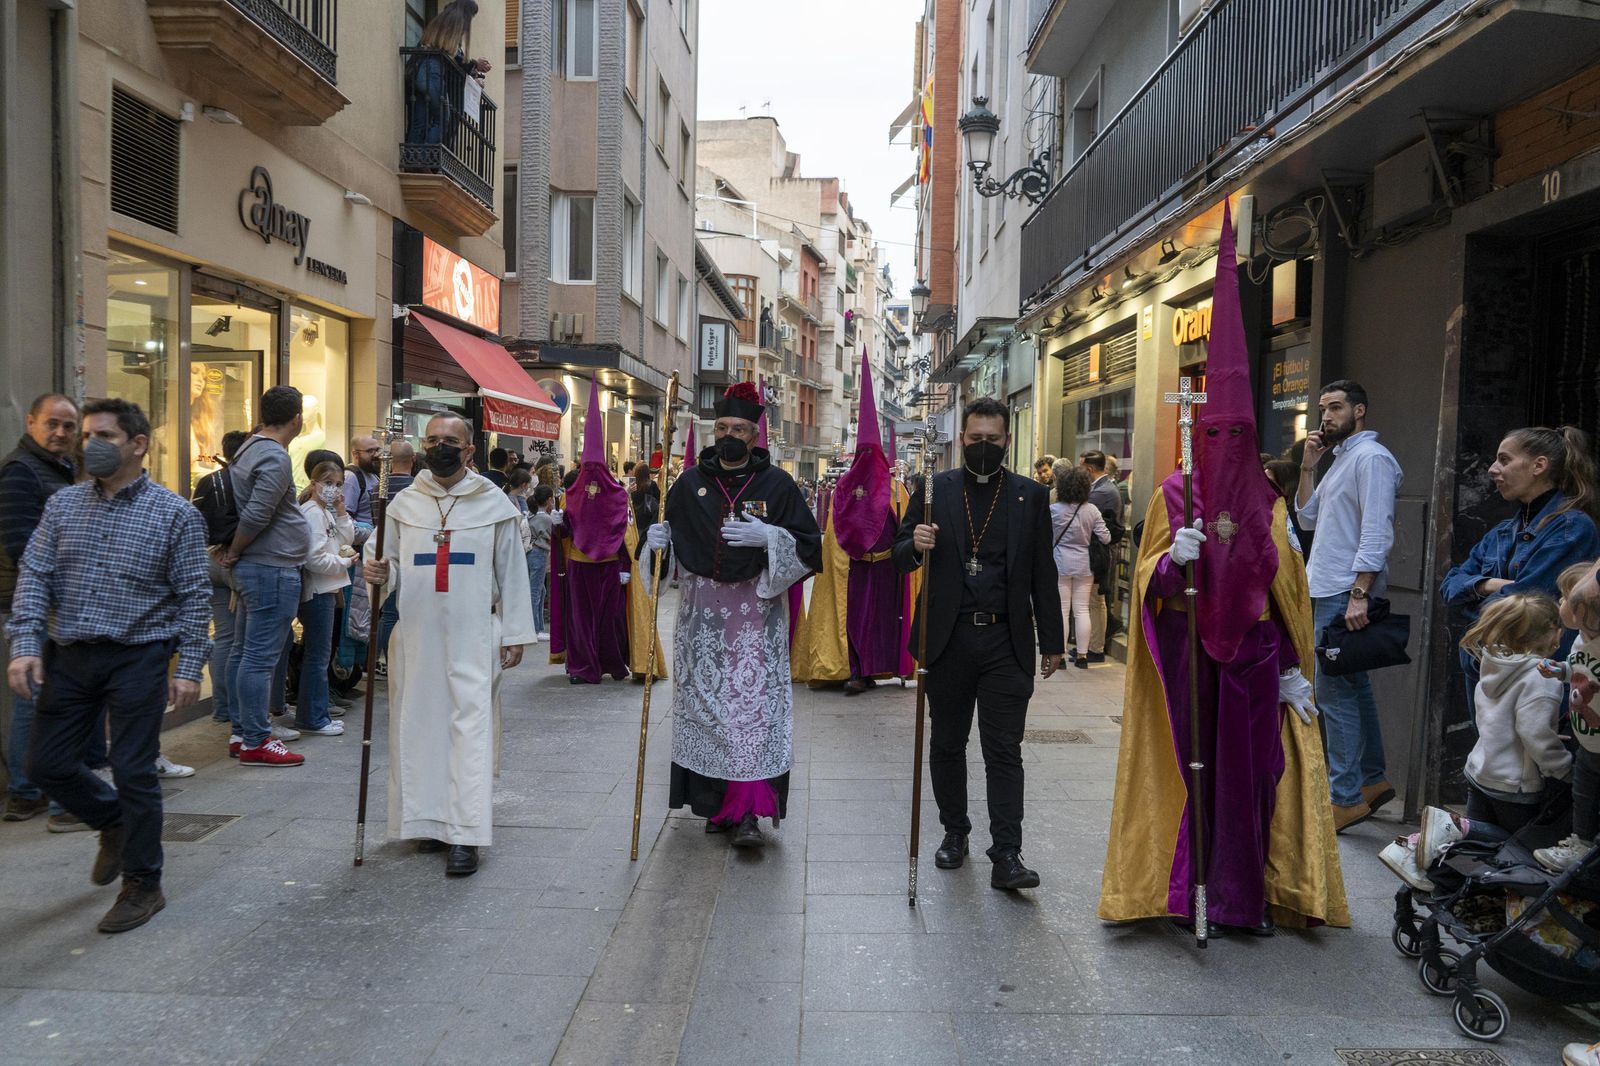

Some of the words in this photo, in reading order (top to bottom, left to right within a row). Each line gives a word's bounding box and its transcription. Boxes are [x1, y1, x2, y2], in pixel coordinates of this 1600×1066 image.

[1542, 171, 1560, 204] 10
[1272, 382, 1282, 396] en
[1272, 397, 1296, 410] Temporada
